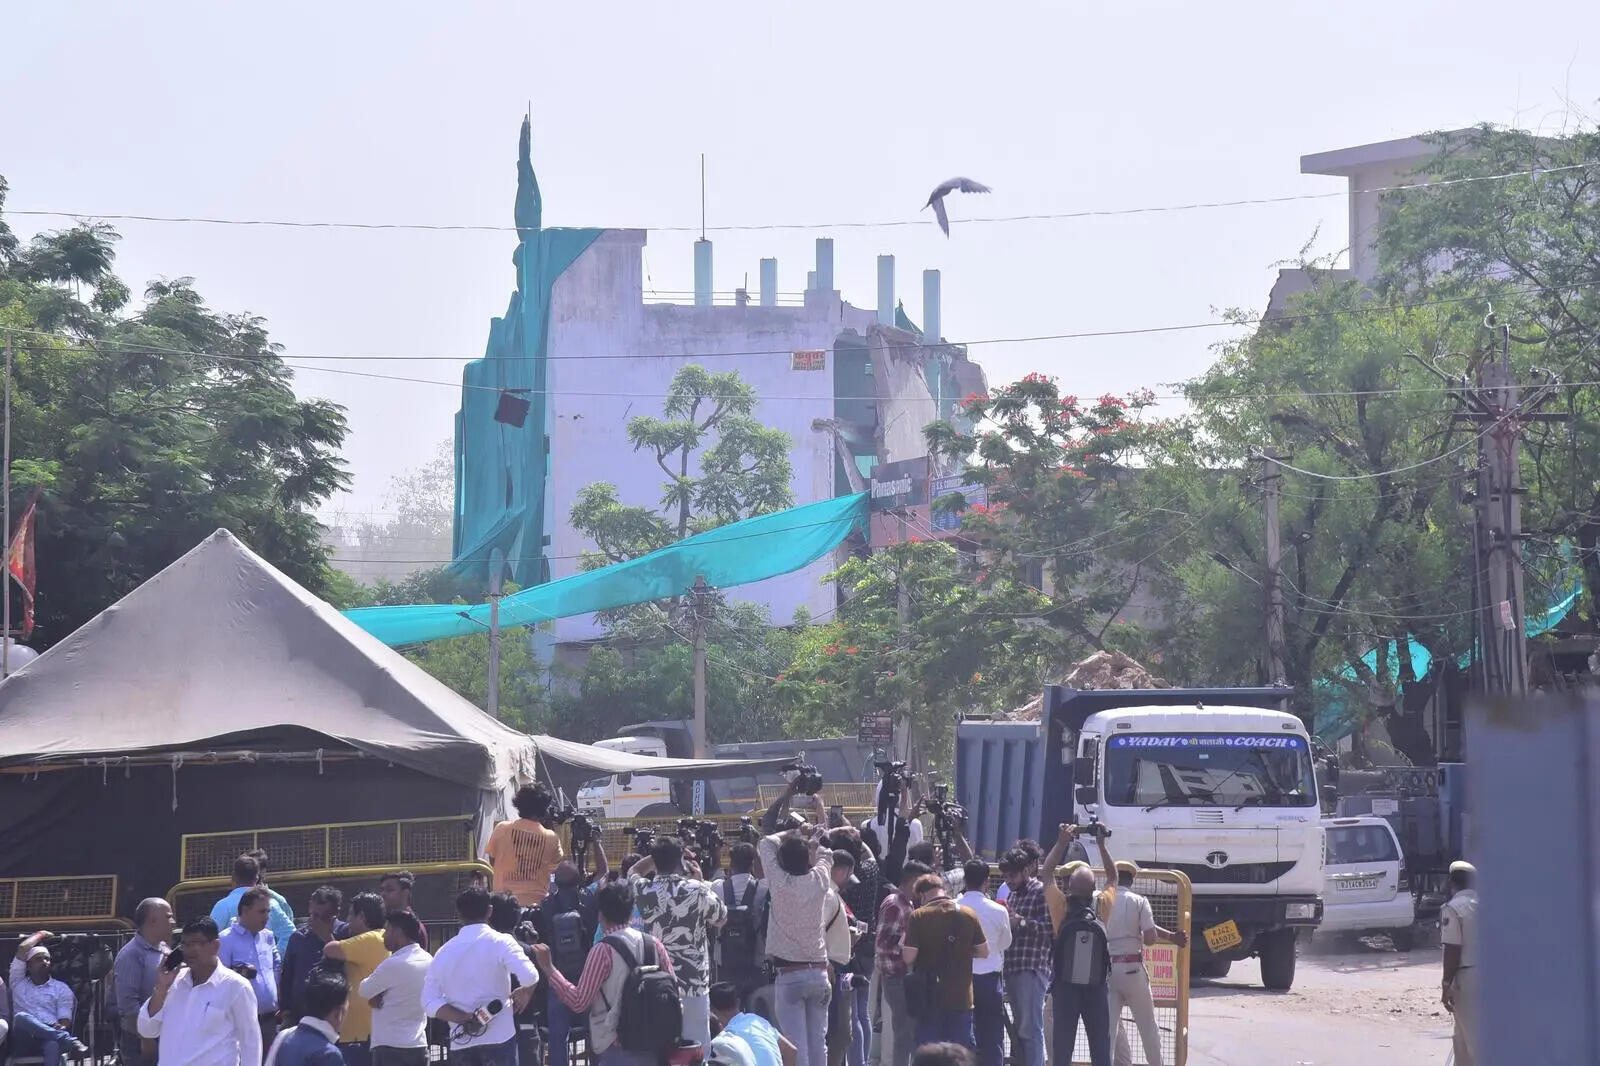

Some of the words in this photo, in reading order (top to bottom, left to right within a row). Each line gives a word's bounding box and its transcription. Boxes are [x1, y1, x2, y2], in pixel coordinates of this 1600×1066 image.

[871, 473, 912, 498] Panasonic
[1128, 737, 1182, 746] YADAV
[1234, 737, 1288, 747] COACH
[1152, 949, 1174, 962] MAHILA
[1153, 965, 1173, 978] JAIPUR
